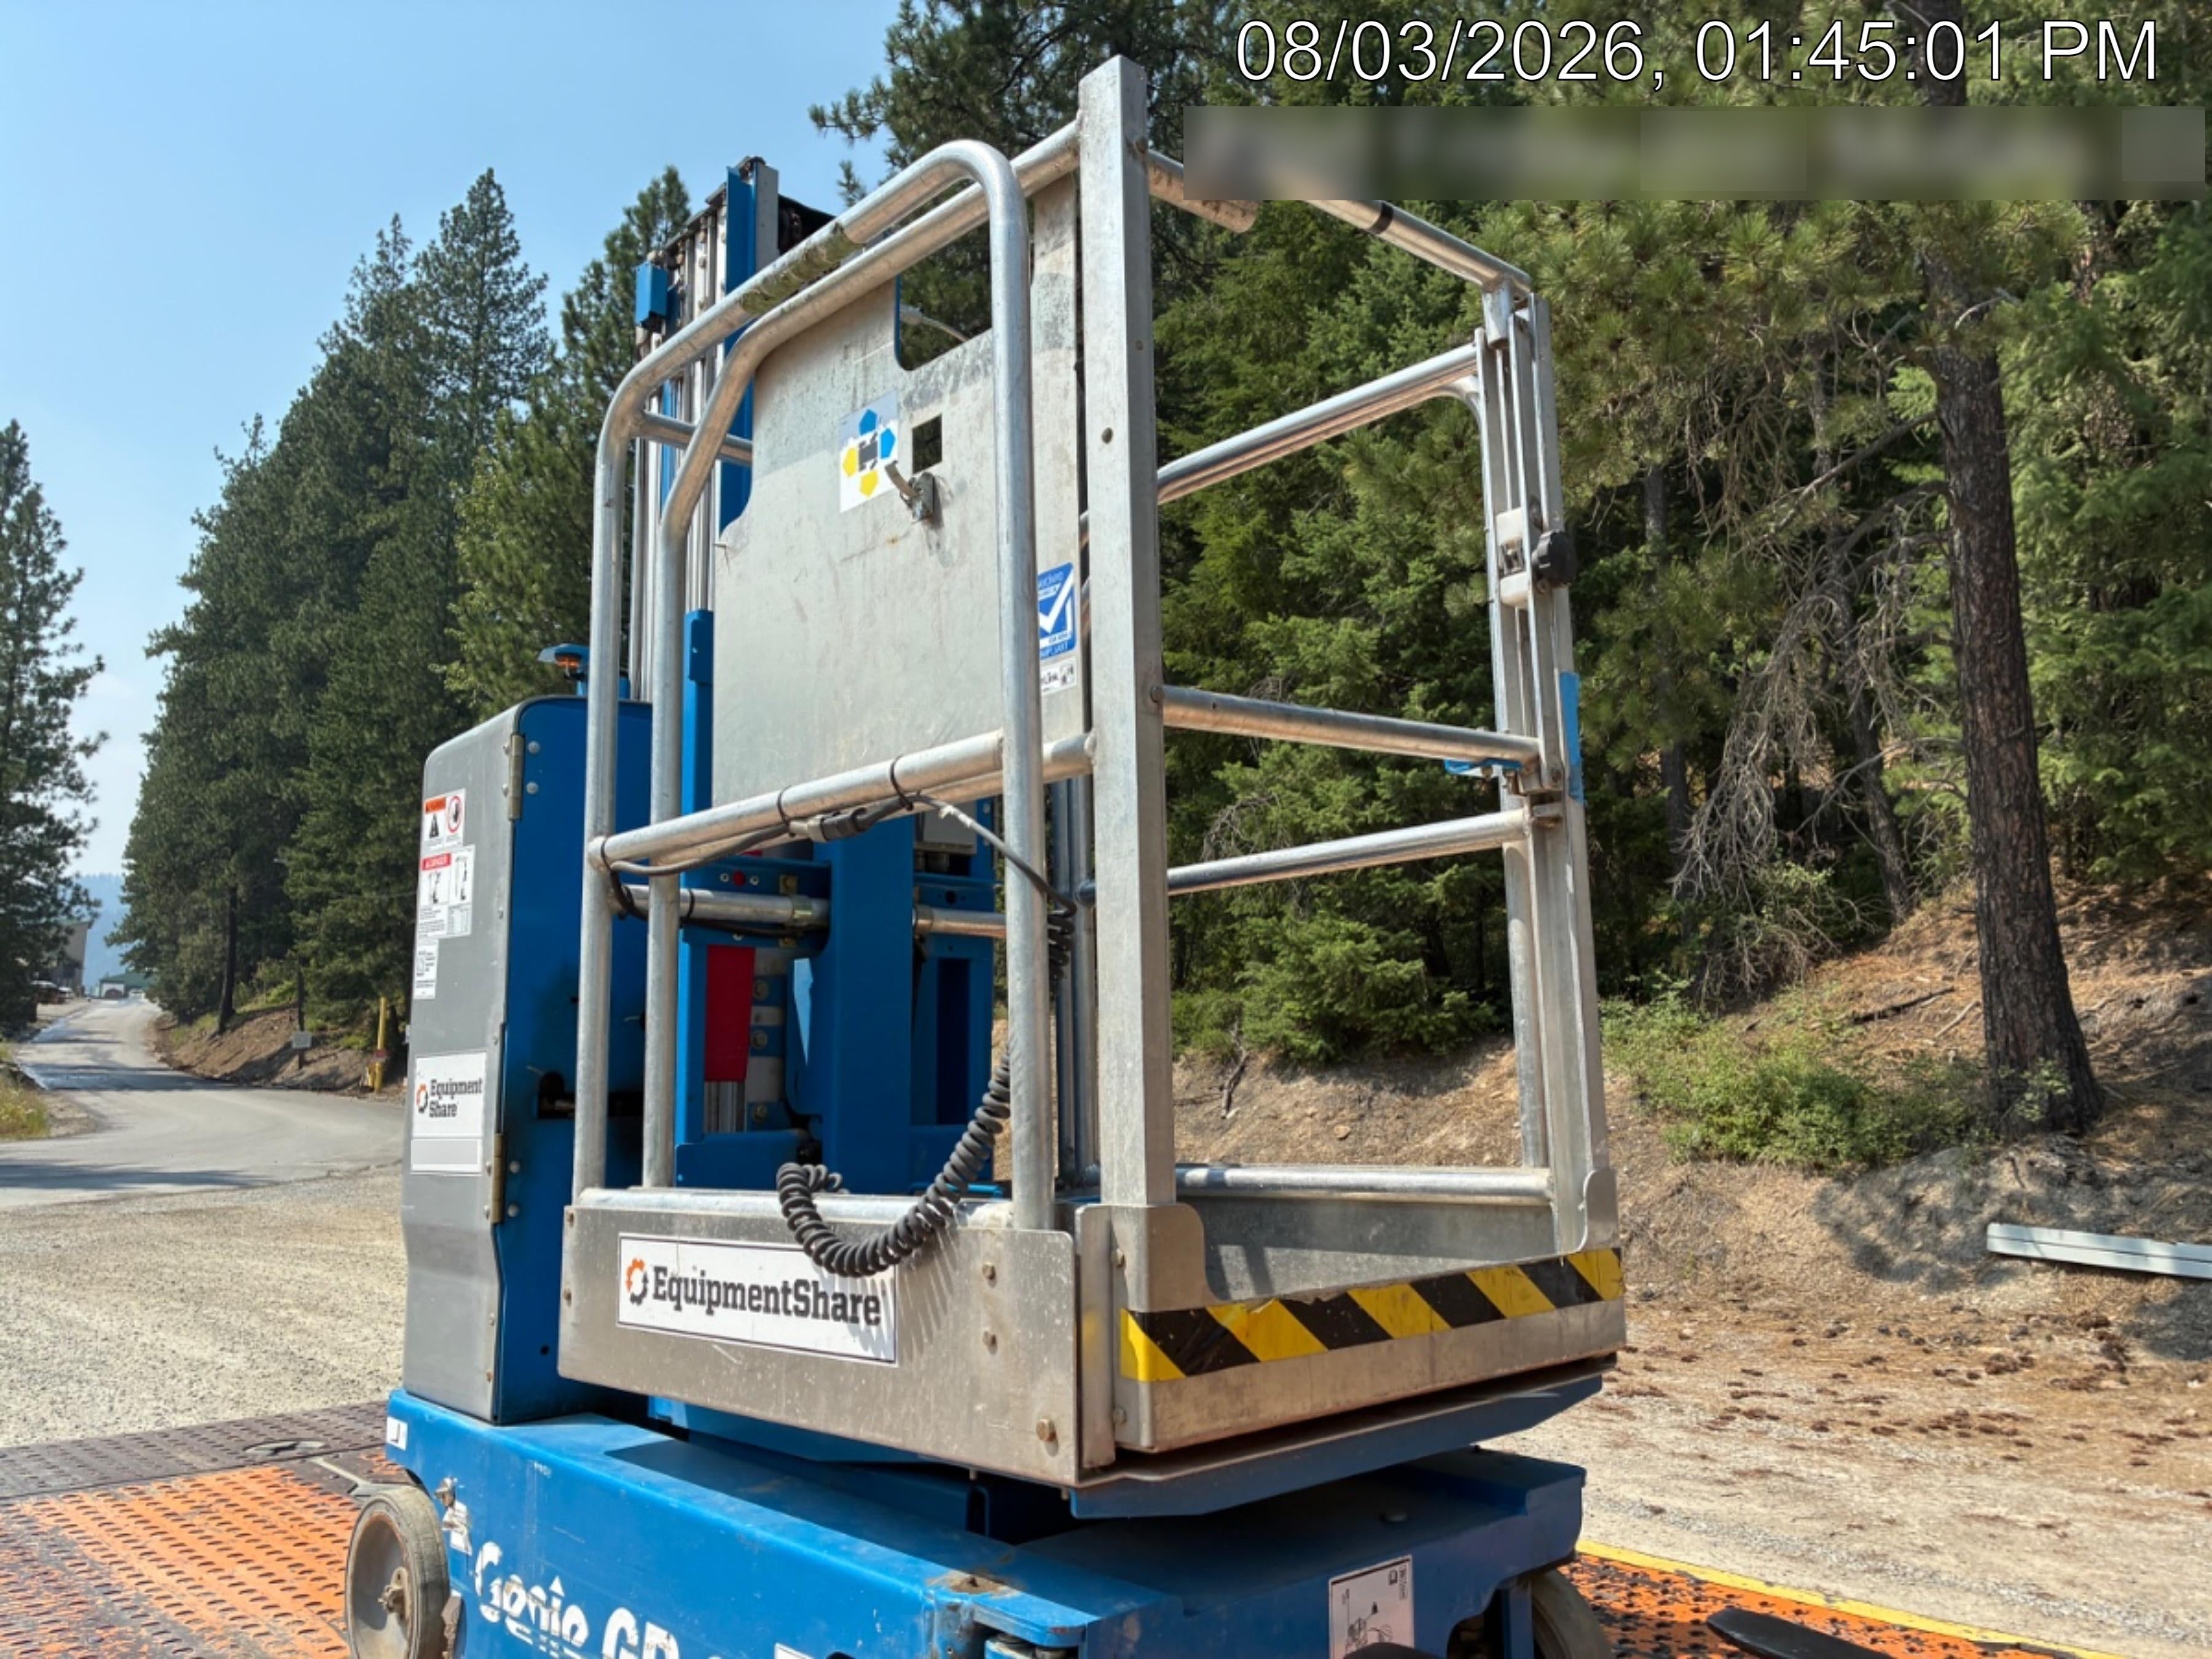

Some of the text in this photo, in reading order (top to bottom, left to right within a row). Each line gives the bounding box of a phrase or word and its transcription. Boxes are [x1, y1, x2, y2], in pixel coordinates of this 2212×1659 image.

[430, 1078, 482, 1100] Equipment
[429, 1100, 458, 1118] Share
[652, 1265, 882, 1327] EquipmentShare
